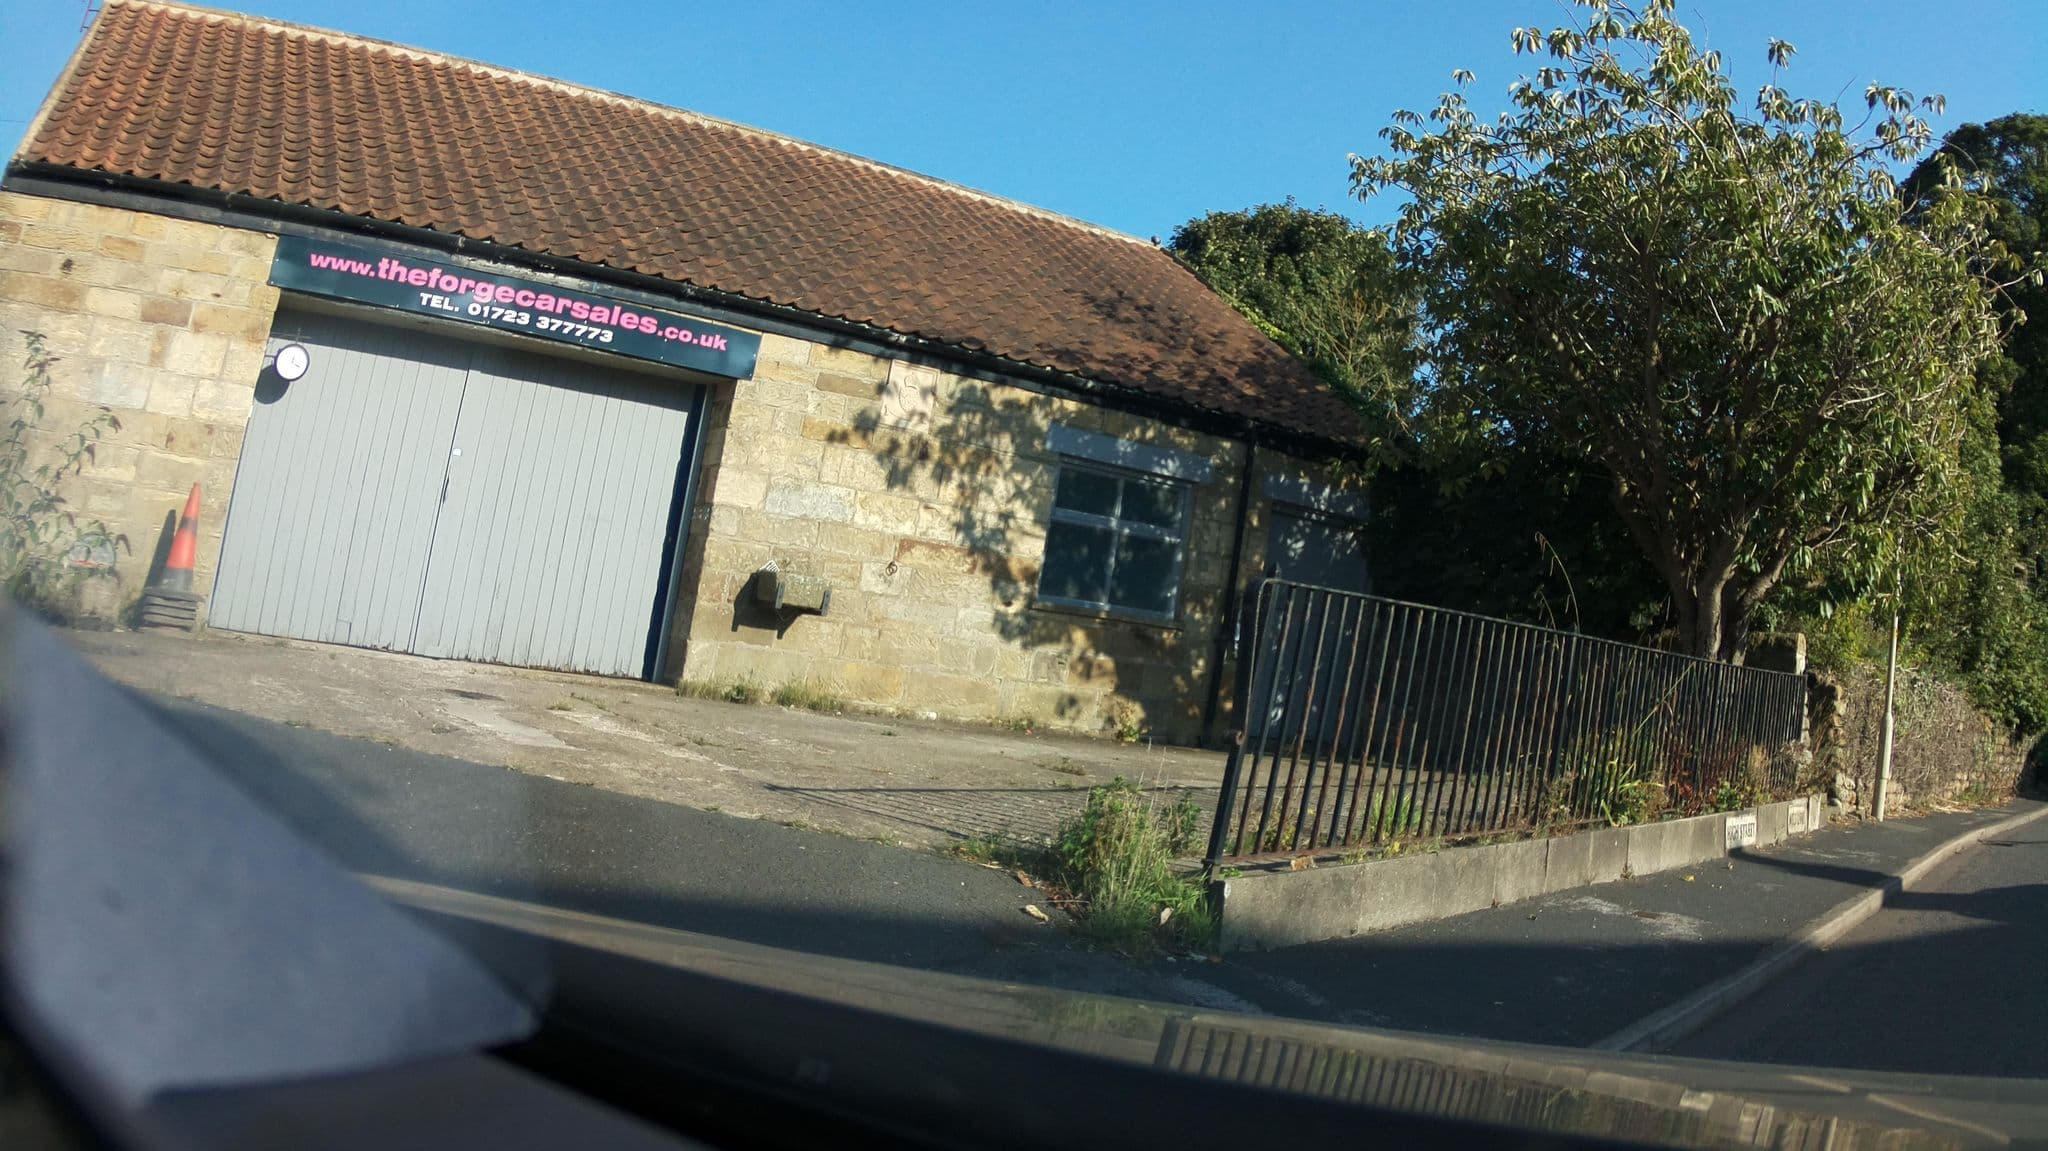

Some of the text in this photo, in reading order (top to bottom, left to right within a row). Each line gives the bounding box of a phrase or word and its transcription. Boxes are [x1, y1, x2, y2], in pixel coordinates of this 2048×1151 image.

[310, 253, 728, 352] www.theforgecarsales.co.uk
[420, 292, 614, 343] TEL. 01723 377773
